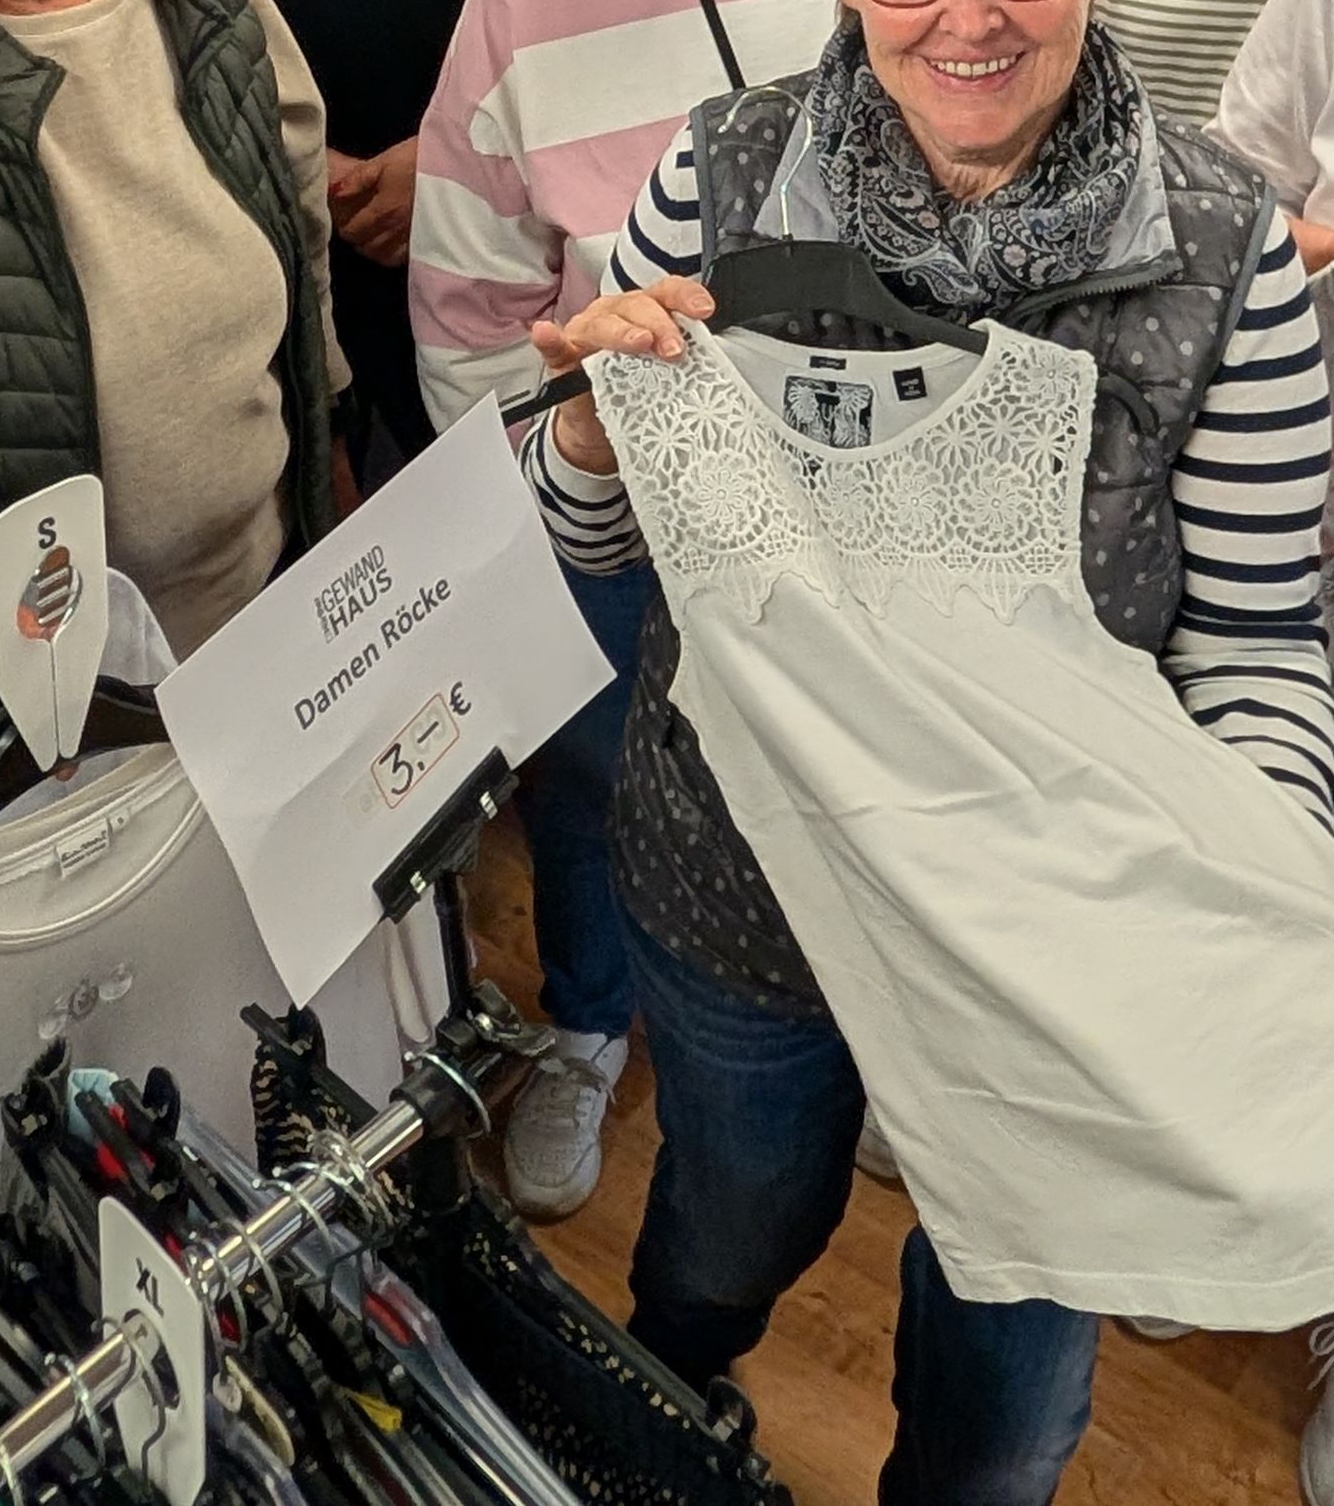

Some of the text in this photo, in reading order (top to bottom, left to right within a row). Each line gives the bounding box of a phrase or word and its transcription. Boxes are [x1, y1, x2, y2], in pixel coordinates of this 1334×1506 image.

[37, 516, 57, 550] S
[320, 544, 385, 614] GEWAND
[328, 567, 393, 637] HAUS
[294, 642, 381, 731] Damen
[379, 577, 452, 650] Röcke
[449, 680, 473, 717] €
[135, 1256, 165, 1319] XL
